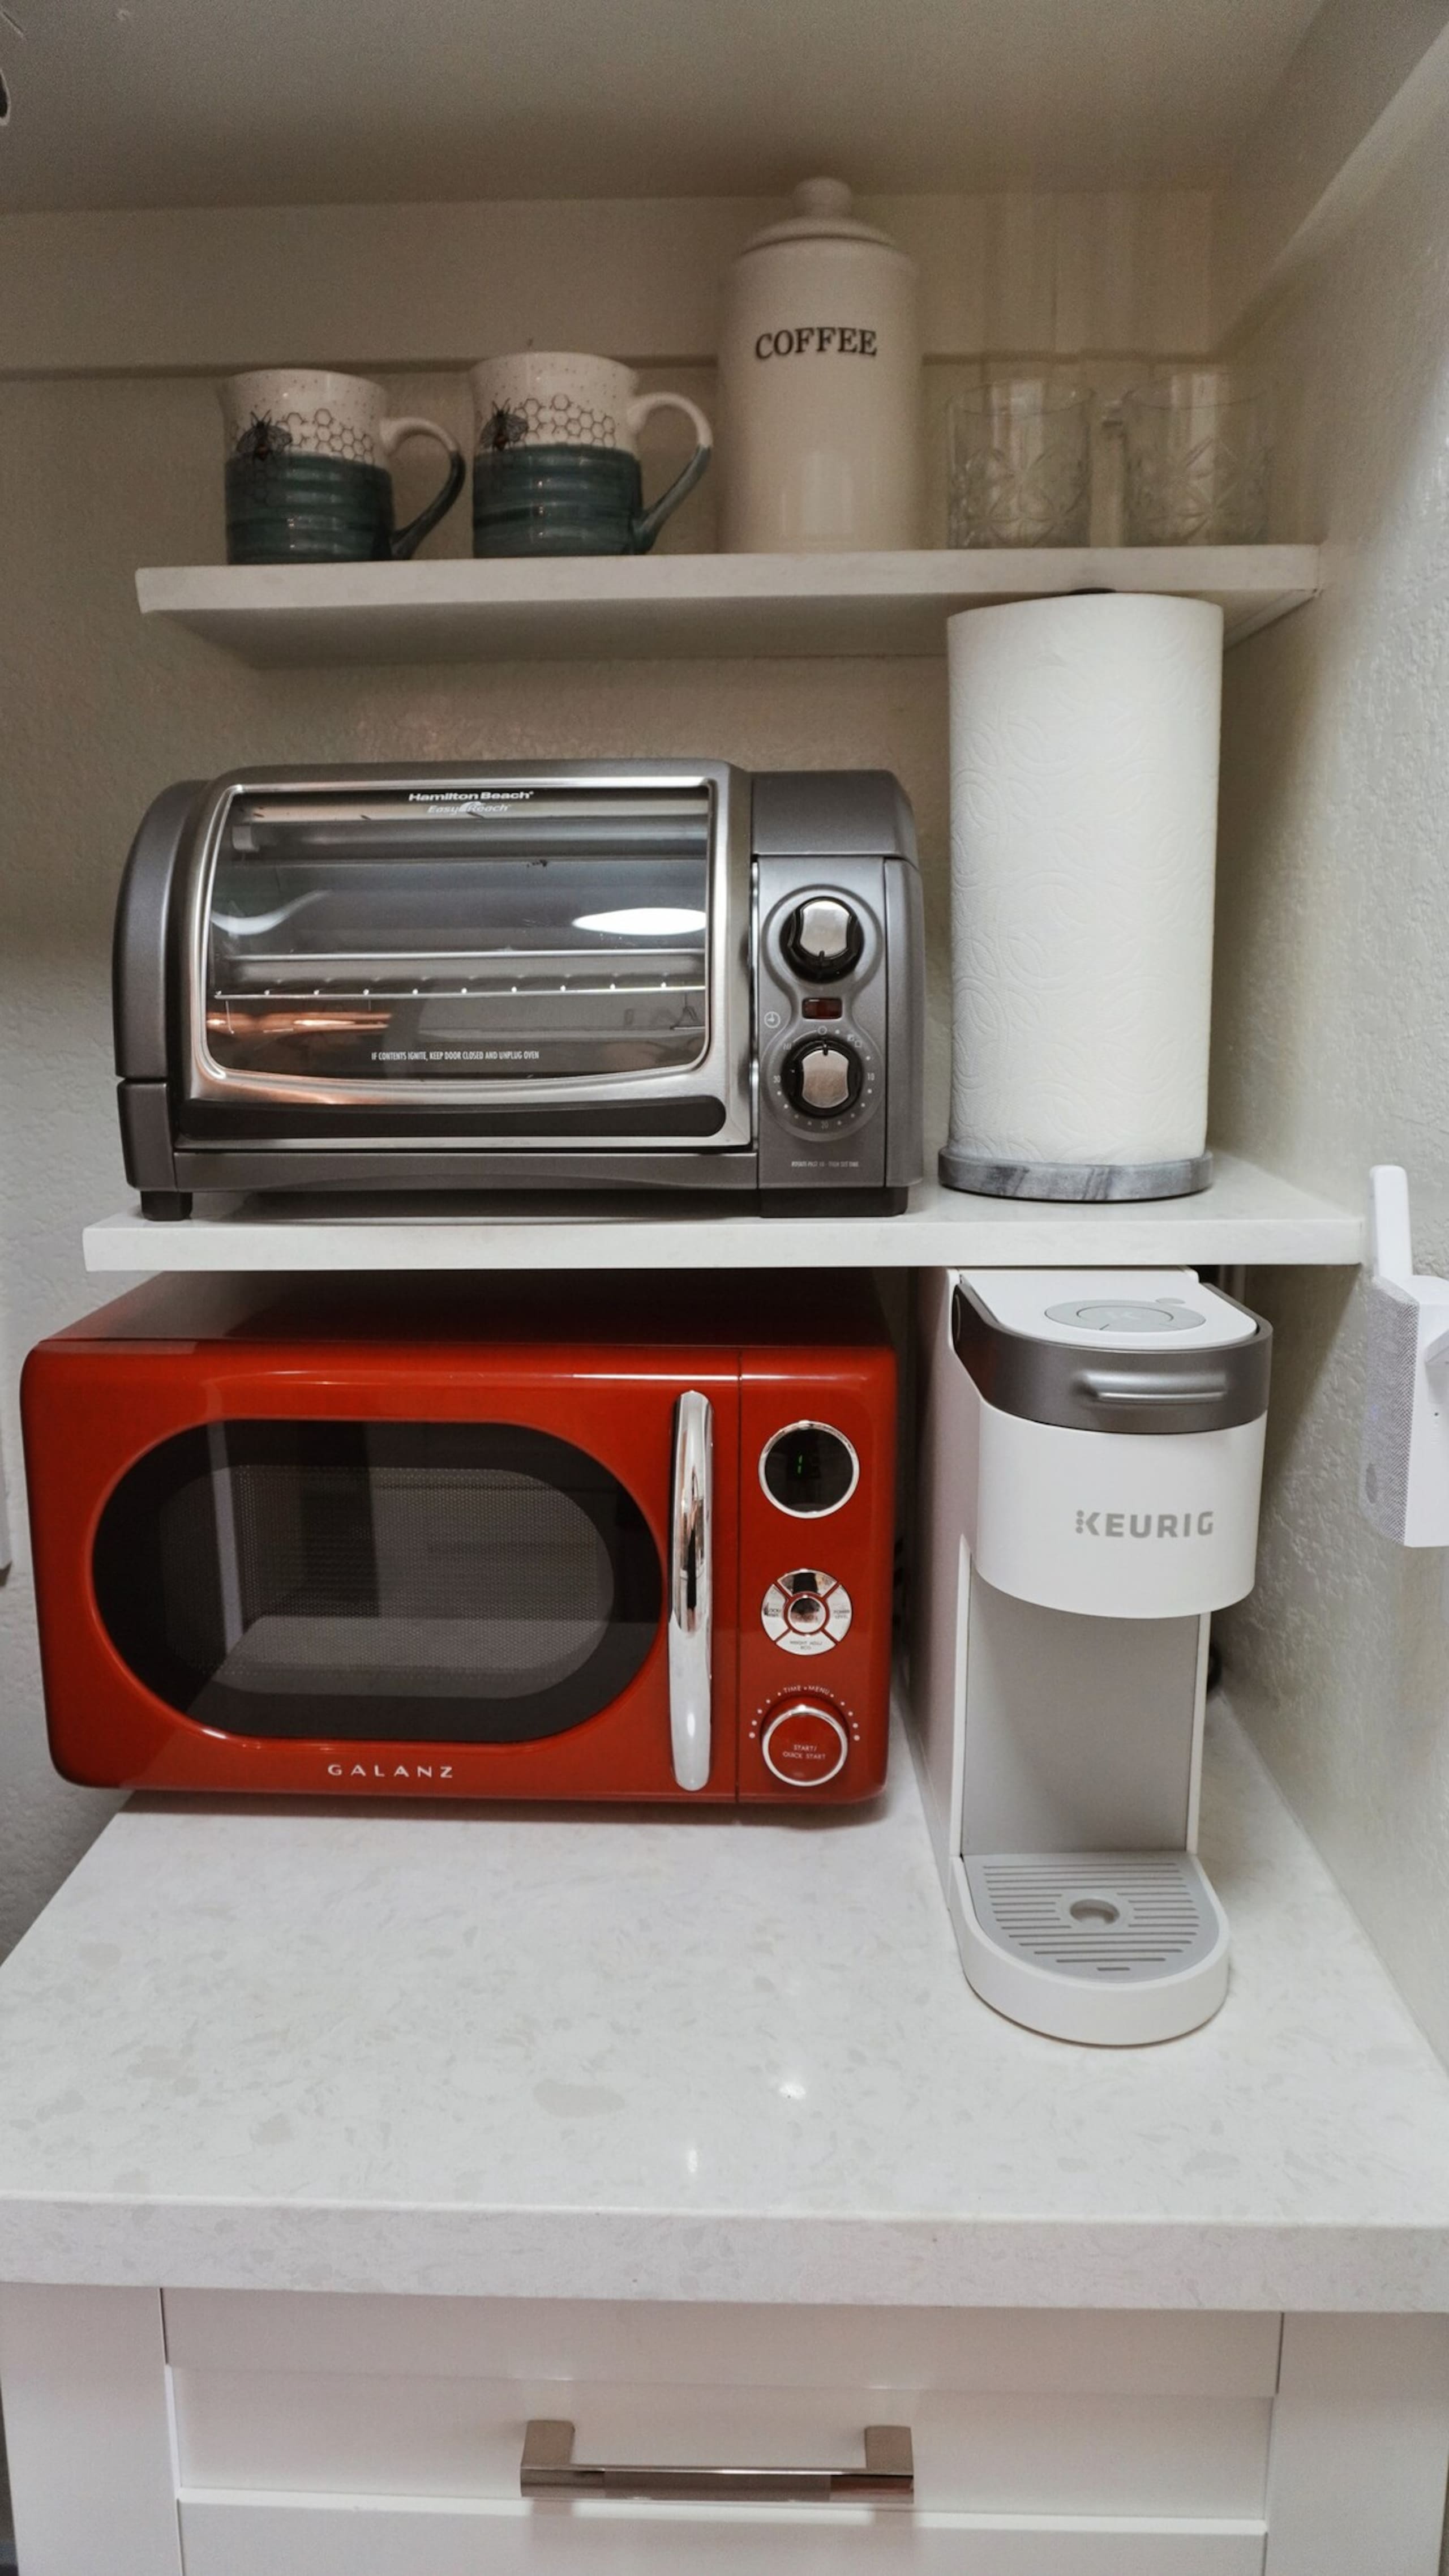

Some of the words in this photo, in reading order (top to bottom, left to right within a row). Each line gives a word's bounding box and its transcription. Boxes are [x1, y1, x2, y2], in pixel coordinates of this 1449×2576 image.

[755, 327, 878, 360] COFFEE
[409, 793, 479, 802] Hamilton
[378, 1051, 407, 1060] CONTENTS
[429, 1051, 444, 1060] KEEP
[444, 1051, 461, 1060] DOOR
[462, 1051, 484, 1060] CLOSED
[485, 1051, 498, 1060] AND
[524, 1051, 539, 1059] OVEN
[1075, 1510, 1214, 1538] KEURIG
[783, 1685, 801, 1693] TIME
[808, 1685, 830, 1694] MENU
[782, 1751, 803, 1759] QUICK
[328, 1764, 453, 1778] GALANZ
